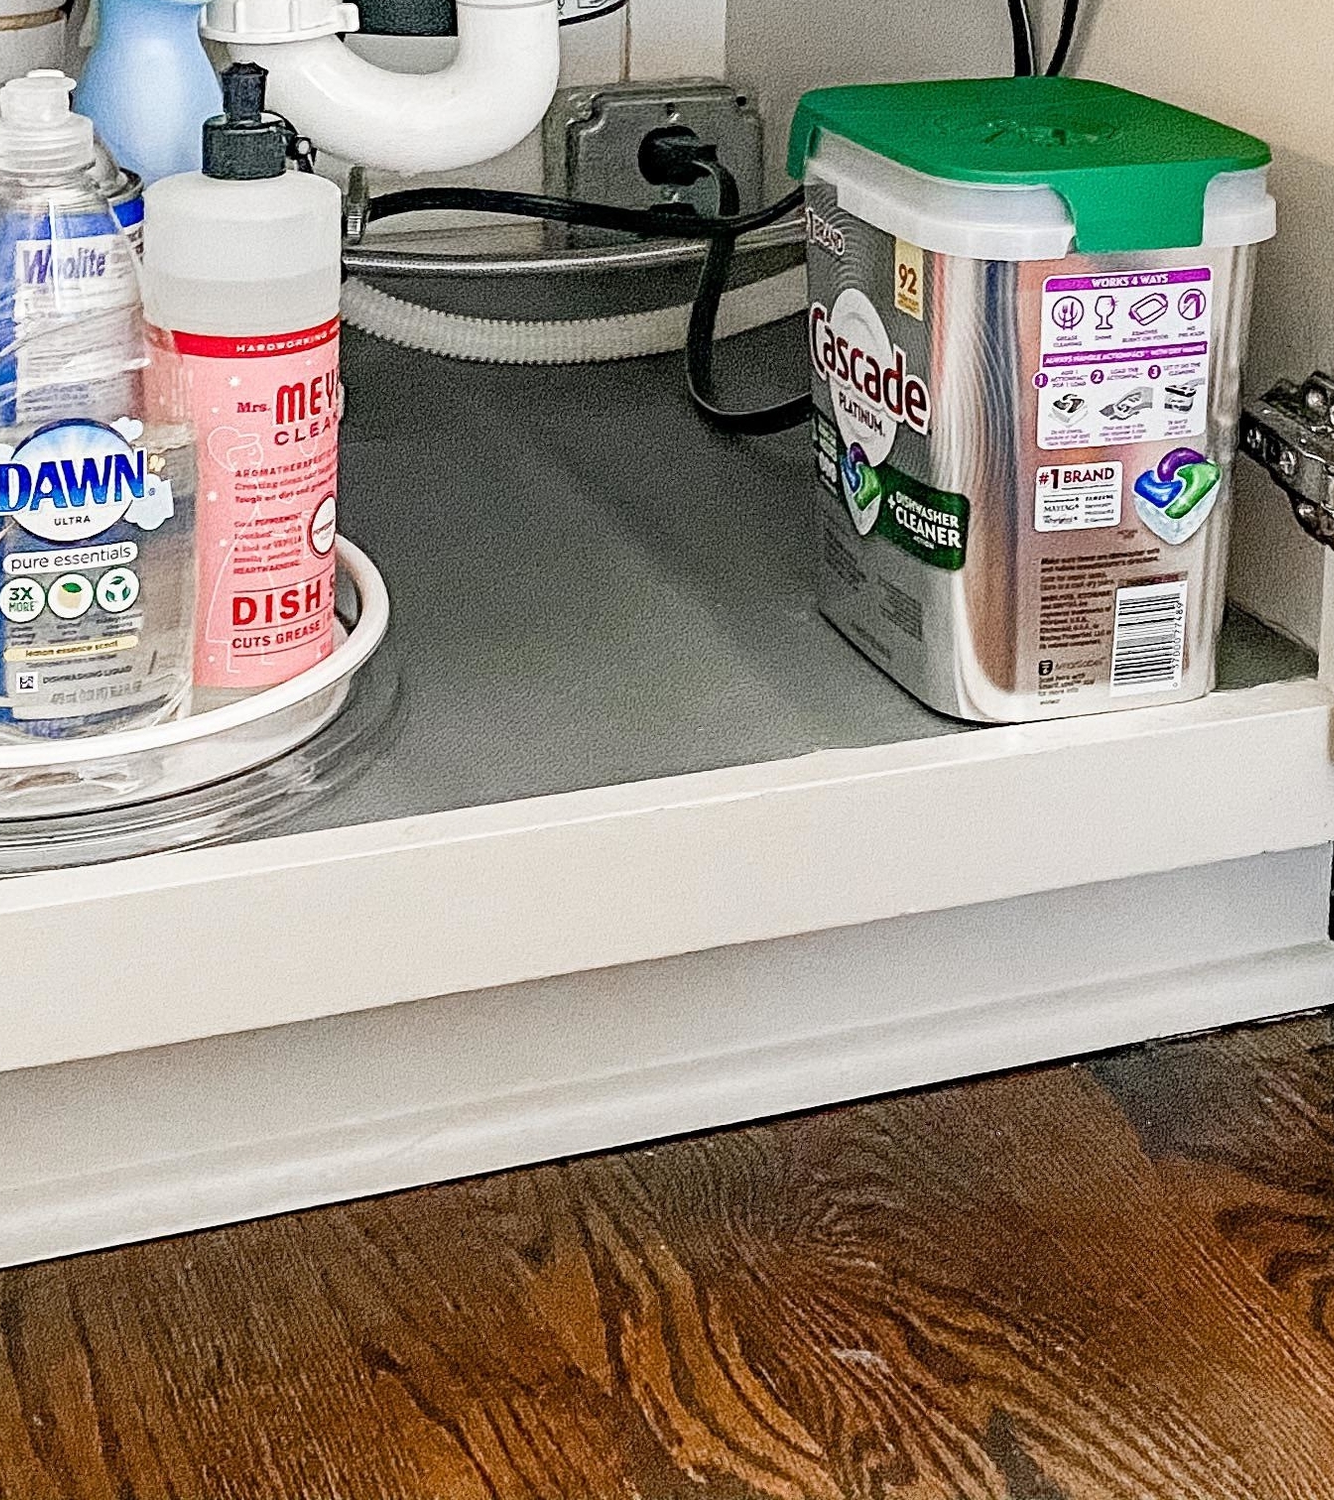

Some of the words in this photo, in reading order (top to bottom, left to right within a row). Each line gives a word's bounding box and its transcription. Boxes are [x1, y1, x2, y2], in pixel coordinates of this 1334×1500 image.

[899, 263, 917, 295] 92
[1091, 276, 1129, 288] WORKS
[1131, 277, 1139, 285] 4
[1140, 274, 1168, 286] WAYS
[812, 306, 928, 428] Cascade
[236, 401, 271, 413] Mrs.
[275, 368, 338, 425] MEY
[838, 392, 883, 436] PLATINUM
[1039, 469, 1059, 489] #1
[1063, 467, 1114, 484] BRAND
[53, 515, 91, 526] ULTRA
[895, 491, 960, 529] DISHWASHER
[895, 506, 962, 549] CLEANER
[11, 553, 49, 572] pure
[54, 544, 131, 567] essentials
[8, 601, 35, 613] MORE
[9, 587, 34, 602] 3X
[232, 579, 321, 626] DISH
[232, 635, 271, 649] CUTS
[276, 619, 320, 645] GREASE
